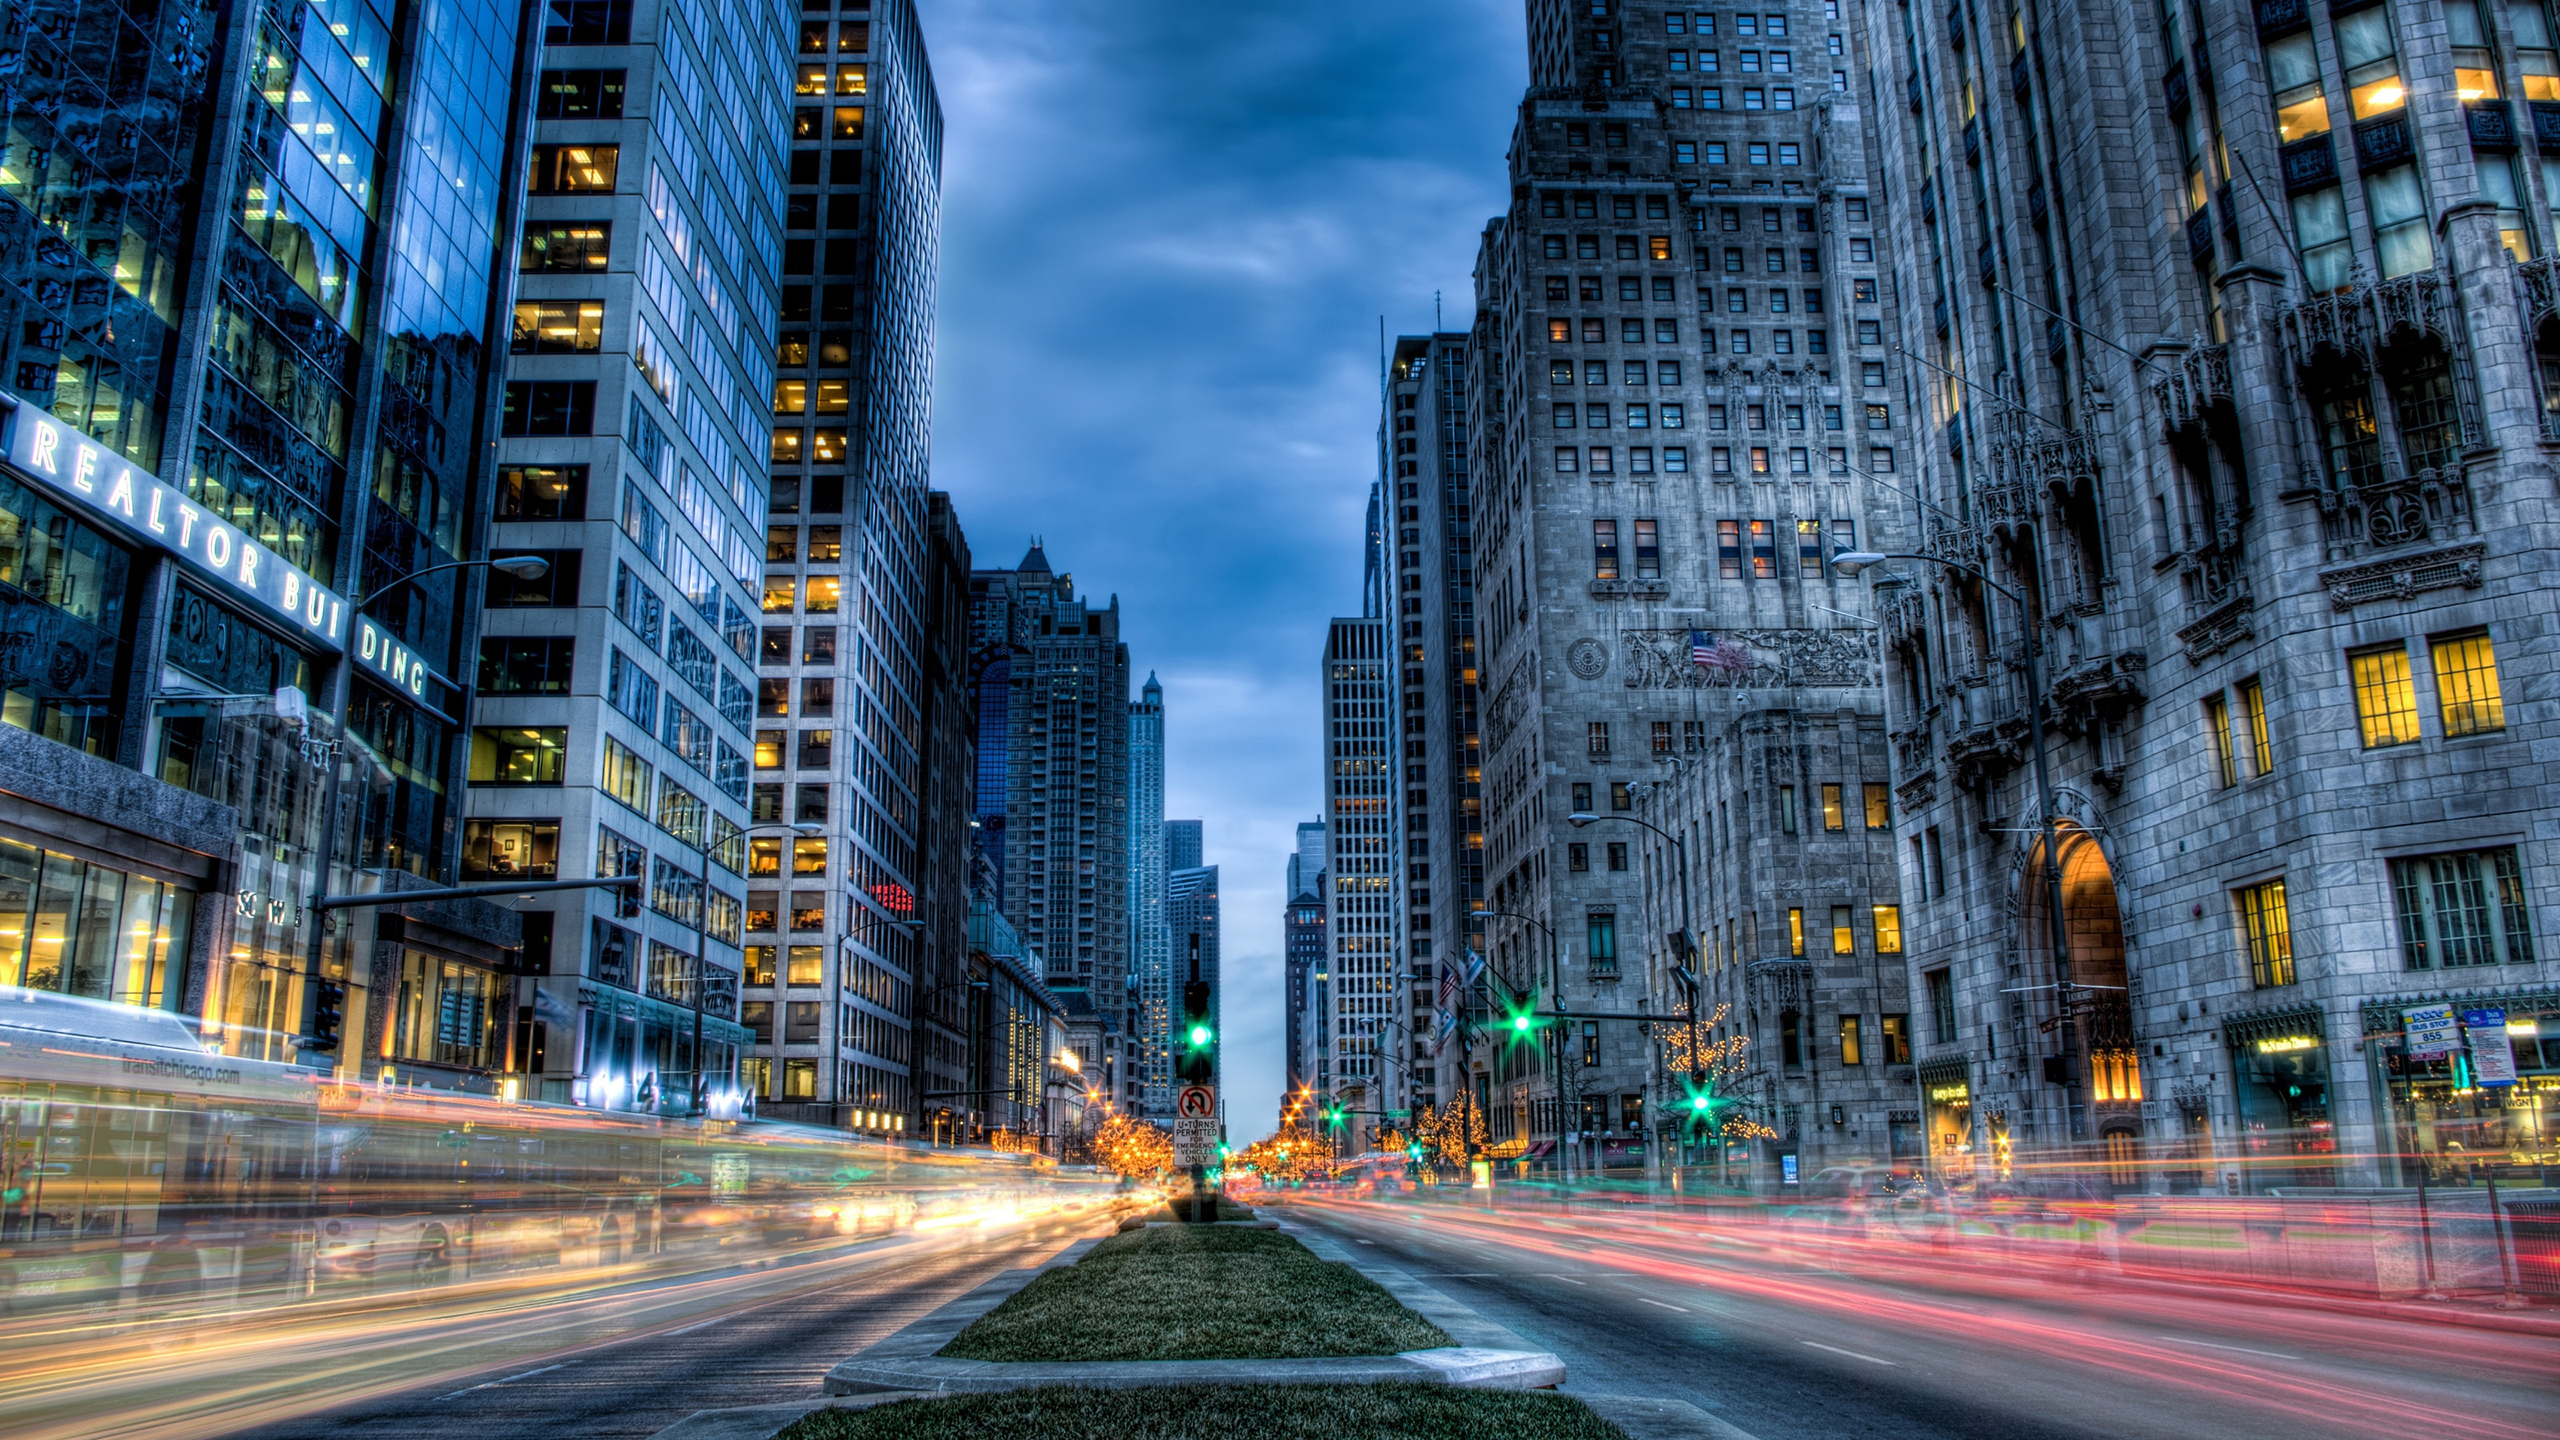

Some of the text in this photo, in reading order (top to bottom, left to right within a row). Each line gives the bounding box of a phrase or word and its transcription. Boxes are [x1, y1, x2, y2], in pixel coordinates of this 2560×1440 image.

[32, 420, 424, 695] REALTOR BUIDING
[2412, 1020, 2449, 1031] BUS STOP
[2422, 1031, 2442, 1042] 855
[122, 1053, 240, 1086] transitchicago.com
[1178, 1121, 1215, 1129] U-TURNS
[1176, 1129, 1217, 1137] PERMITTED
[1185, 1155, 1208, 1163] ONLY
